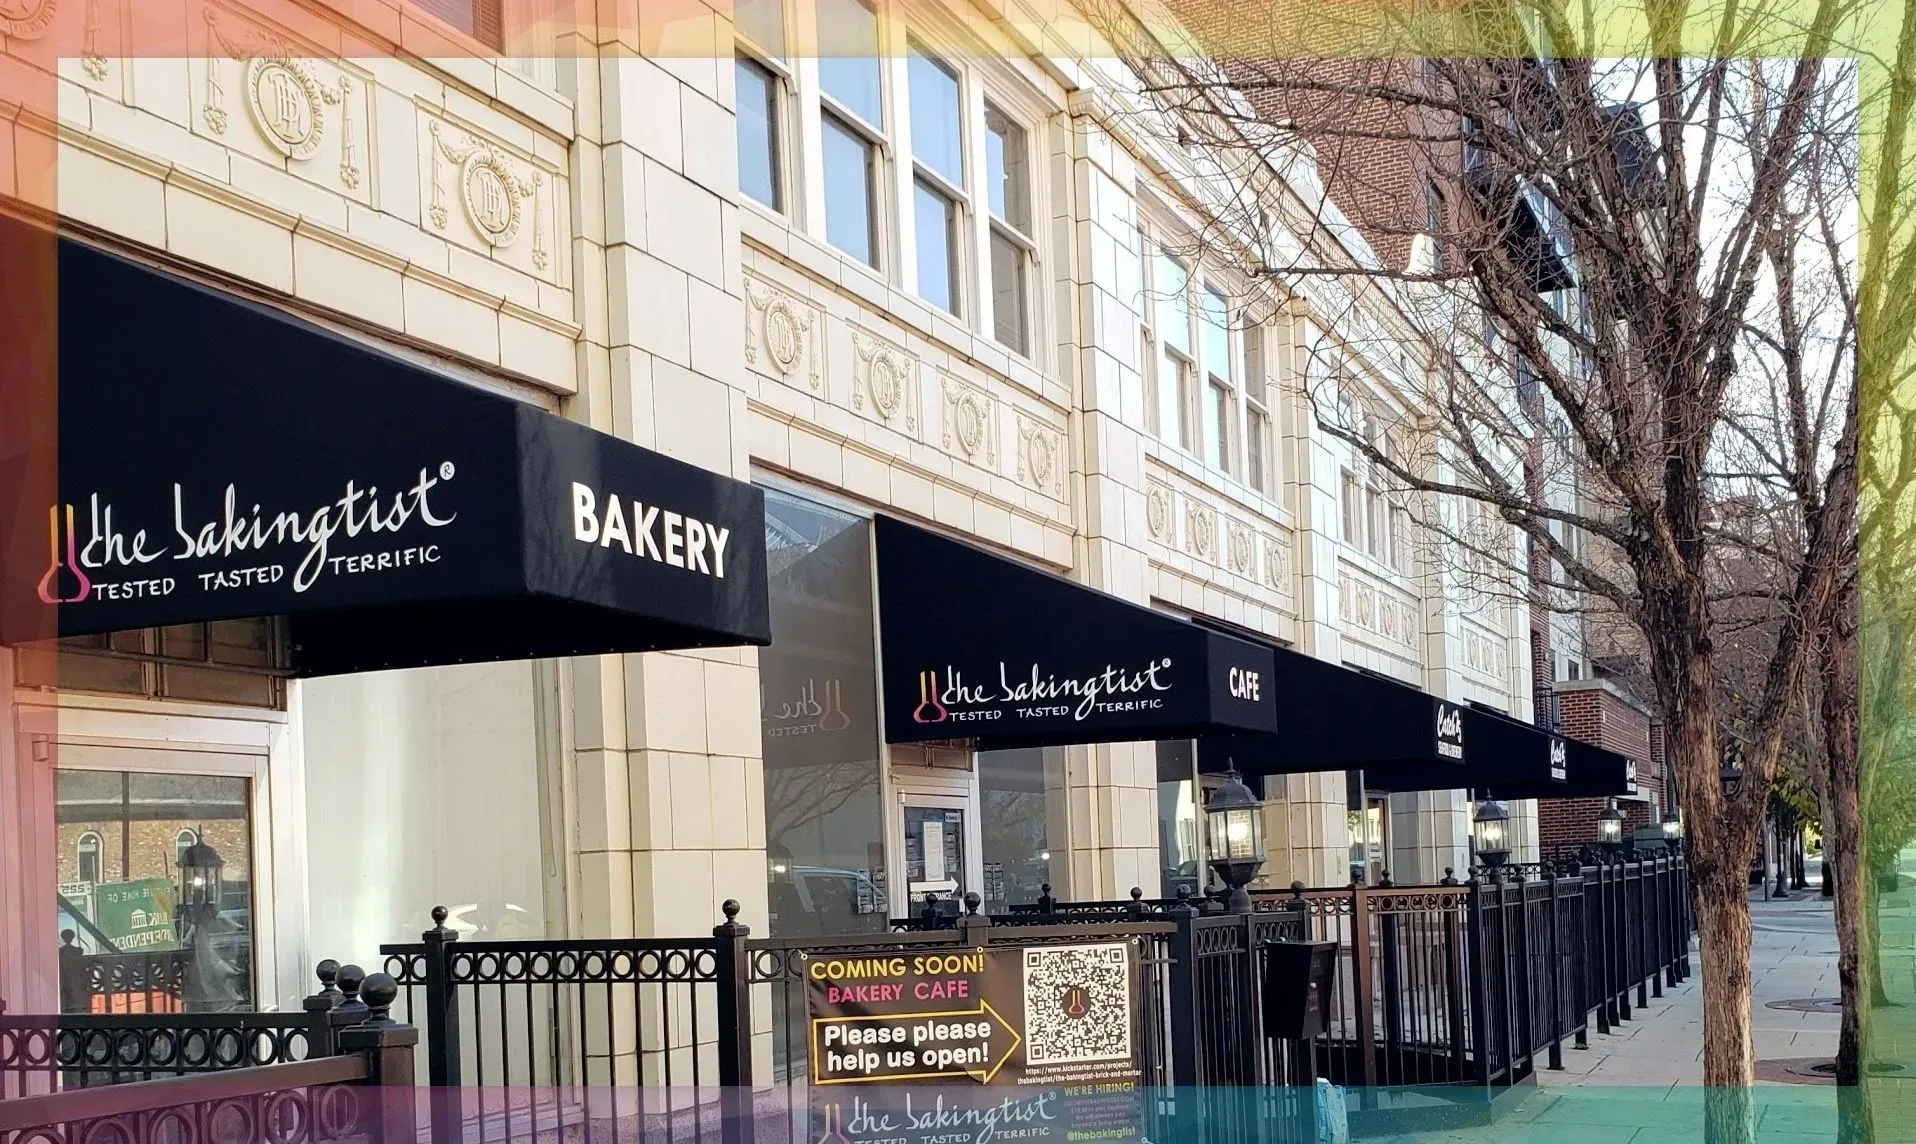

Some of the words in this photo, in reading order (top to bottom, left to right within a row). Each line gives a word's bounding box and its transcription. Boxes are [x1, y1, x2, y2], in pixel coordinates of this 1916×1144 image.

[81, 492, 168, 569] the
[572, 480, 730, 580] BAKERY
[91, 577, 176, 601] TESTED
[199, 564, 285, 591] TASTED
[328, 545, 441, 574] TERRIFIC
[941, 664, 997, 704] the
[1228, 665, 1260, 702] CAFE
[949, 709, 1002, 722] TESTED
[1016, 705, 1069, 719] TASTED
[1095, 699, 1164, 713] TERRIFIC
[811, 958, 907, 980] COMING
[913, 954, 985, 976] SOON!
[828, 983, 903, 1004] BAKERY
[914, 980, 969, 1000] CAFE
[824, 1023, 907, 1046] Please
[913, 1020, 992, 1050] please
[827, 1048, 880, 1074] help
[886, 1051, 916, 1068] us
[922, 1041, 990, 1072] open!
[1064, 1085, 1093, 1097] WE'RE
[1095, 1081, 1134, 1094] HIRING!
[848, 1096, 900, 1133] the
[994, 1126, 1051, 1140] TERRIFIC
[1066, 1126, 1136, 1141] @thebakingtist
